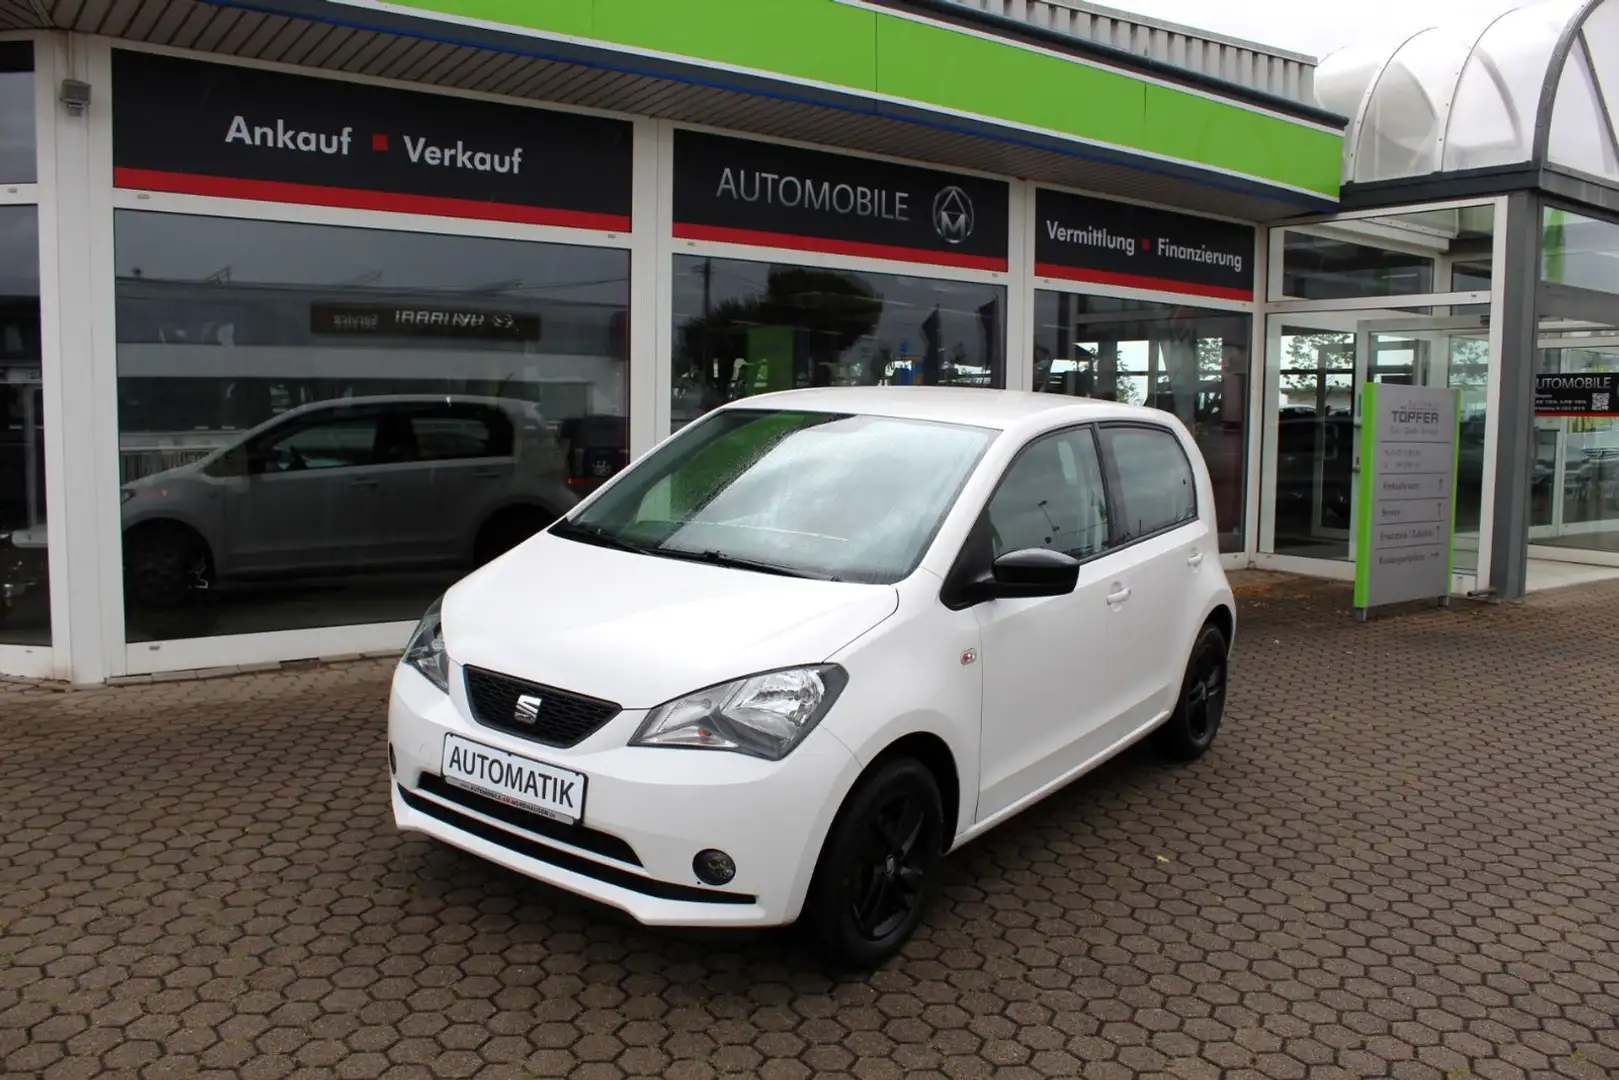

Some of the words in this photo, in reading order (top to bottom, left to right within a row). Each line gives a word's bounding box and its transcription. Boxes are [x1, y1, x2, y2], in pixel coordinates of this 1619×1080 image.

[225, 115, 352, 156] Ankauf
[403, 134, 523, 175] Verkauf
[716, 167, 910, 221] AUTOMOBILE
[1046, 219, 1135, 256] Vermittlung
[1158, 237, 1243, 273] Finanzierung
[1536, 376, 1612, 389] UTOMOBILE
[1391, 405, 1439, 425] TÖPFER
[449, 745, 575, 809] AUTOMATIK
